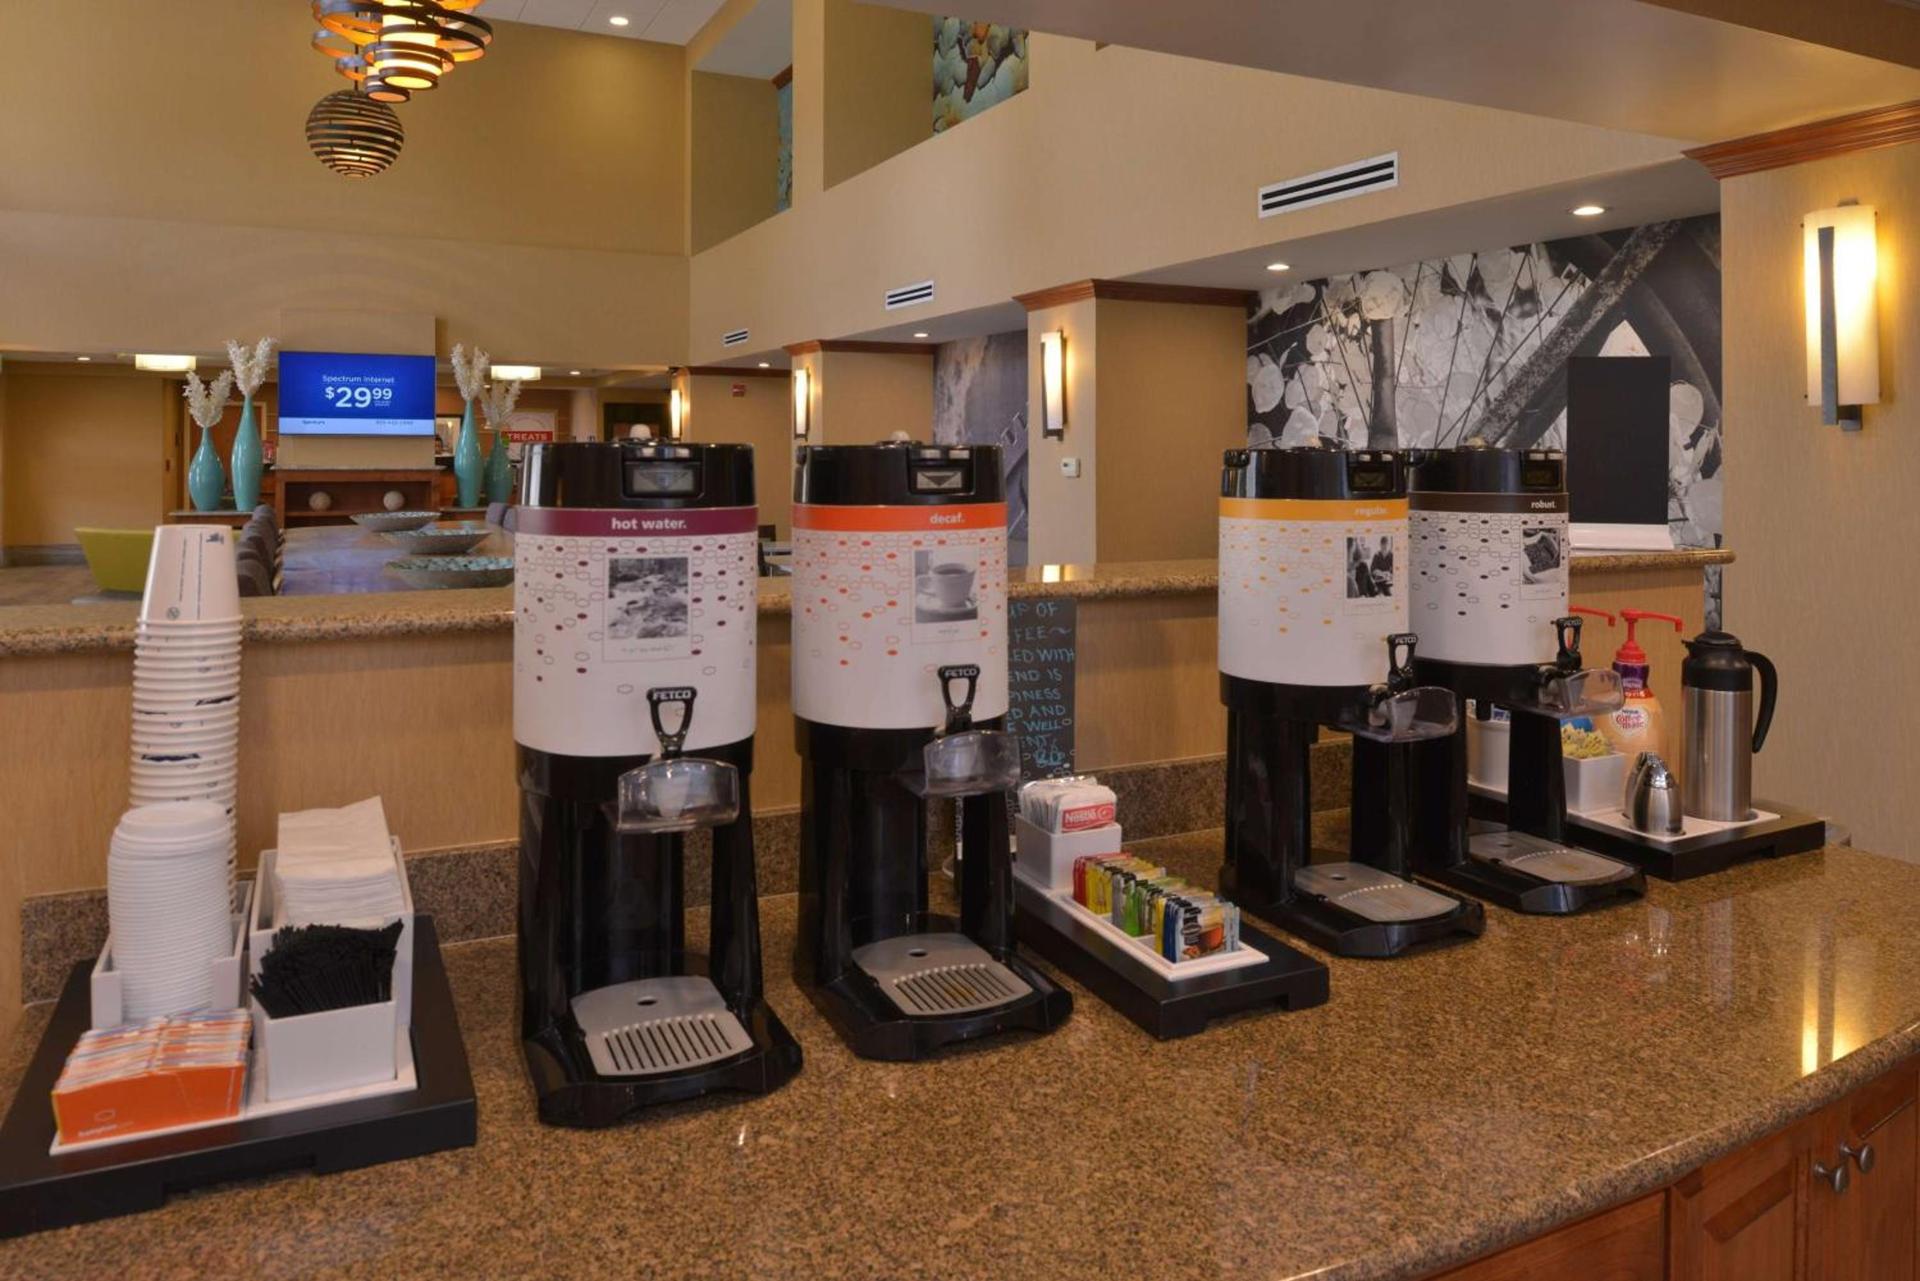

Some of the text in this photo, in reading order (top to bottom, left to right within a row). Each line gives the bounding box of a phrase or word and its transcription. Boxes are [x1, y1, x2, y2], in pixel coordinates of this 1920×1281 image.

[322, 374, 395, 384] Spectrum Internet
[611, 516, 687, 530] hot water.
[929, 511, 966, 525] decaf.
[1036, 602, 1059, 617] OF
[1036, 648, 1075, 663] WITH
[944, 668, 978, 679] FETCO
[653, 690, 692, 700] FETCO
